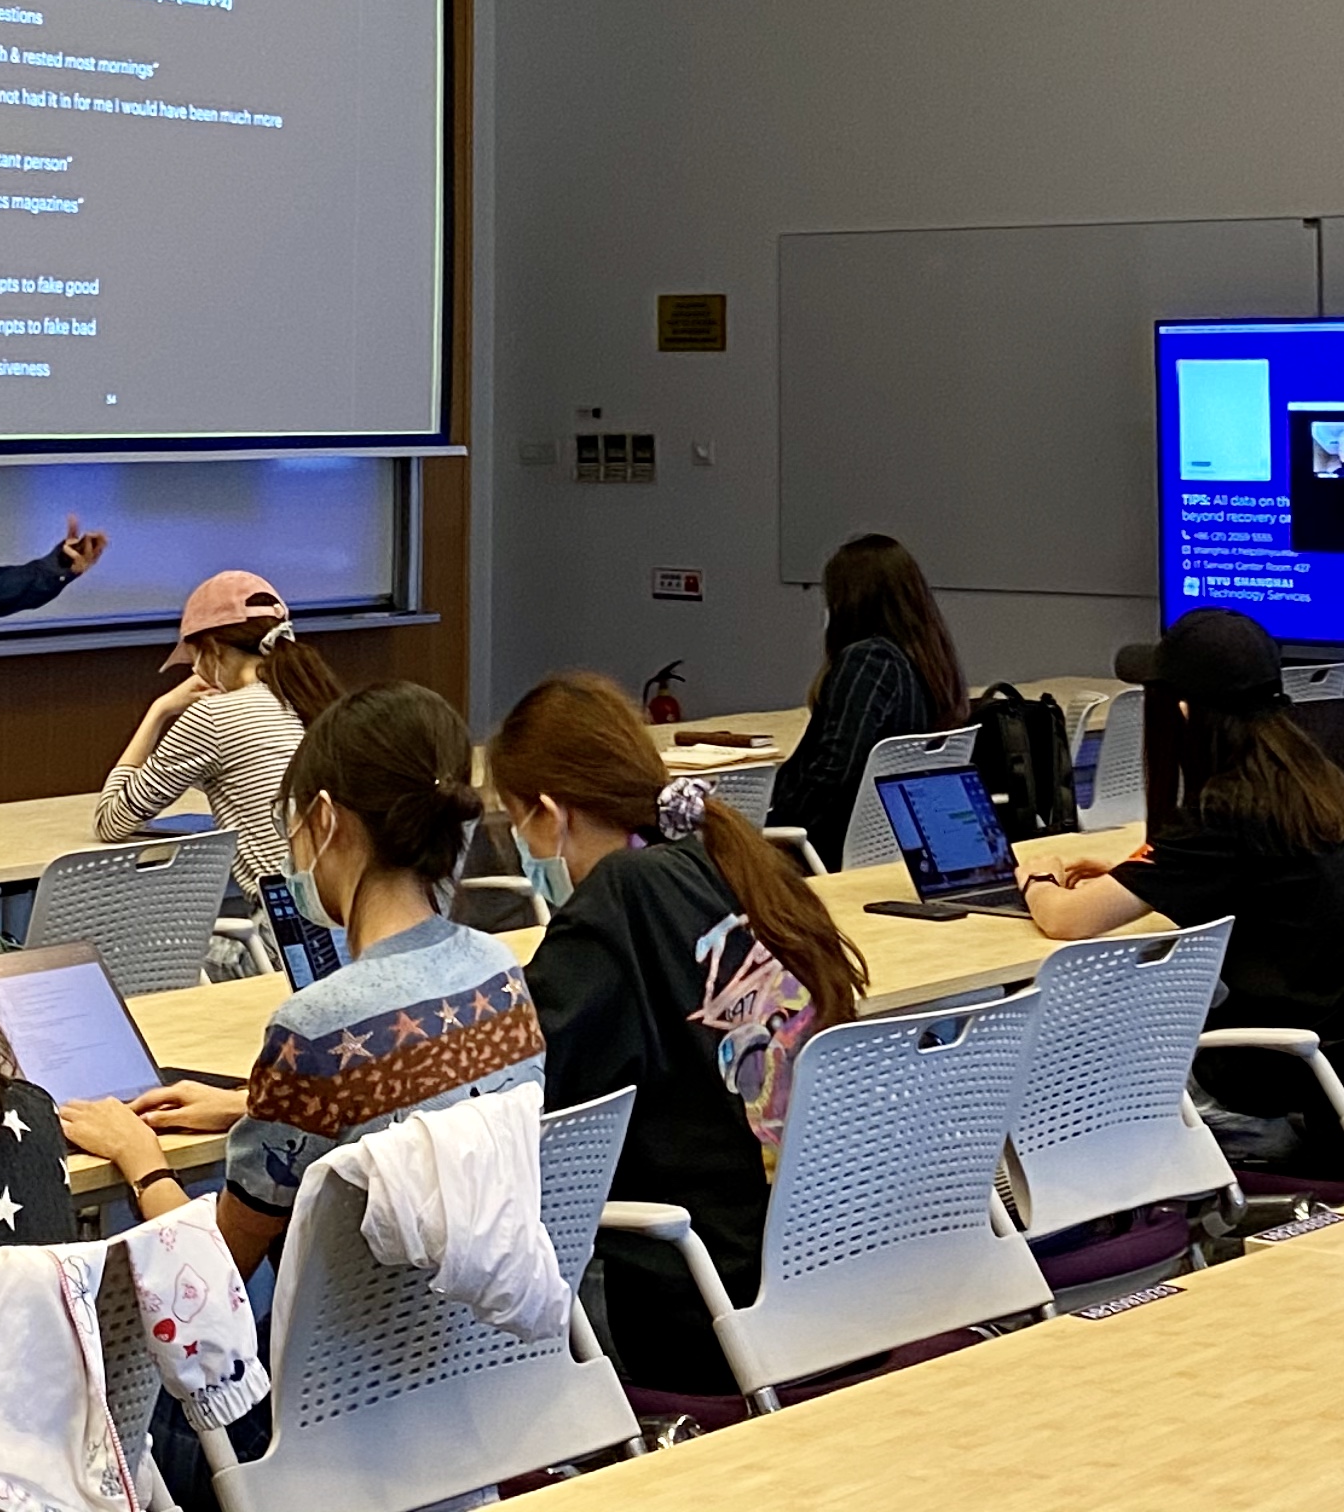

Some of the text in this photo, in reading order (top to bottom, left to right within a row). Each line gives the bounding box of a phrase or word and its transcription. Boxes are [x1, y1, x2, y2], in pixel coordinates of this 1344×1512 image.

[10, 47, 21, 64] &
[22, 51, 64, 68] rested
[64, 56, 96, 72] most
[22, 88, 47, 107] had
[47, 91, 58, 108] it
[59, 92, 72, 109] in
[73, 92, 92, 110] for
[93, 97, 114, 113] me
[120, 99, 158, 117] would
[159, 101, 188, 120] have
[188, 104, 219, 122] been
[219, 108, 252, 125] much
[253, 113, 284, 129] more
[21, 277, 36, 293] to
[37, 276, 65, 294] fake
[65, 278, 100, 297] good
[27, 319, 42, 334] to
[43, 317, 71, 336] fake
[71, 317, 97, 336] bad
[1181, 494, 1211, 506] TIPS:
[1213, 495, 1228, 506] All
[1230, 495, 1257, 507] data
[1258, 497, 1275, 507] on
[1181, 509, 1225, 523] beyond
[1226, 513, 1277, 525] recovery
[1206, 576, 1294, 588] NYU SHANGHAI
[1208, 587, 1312, 603] Technology Services
